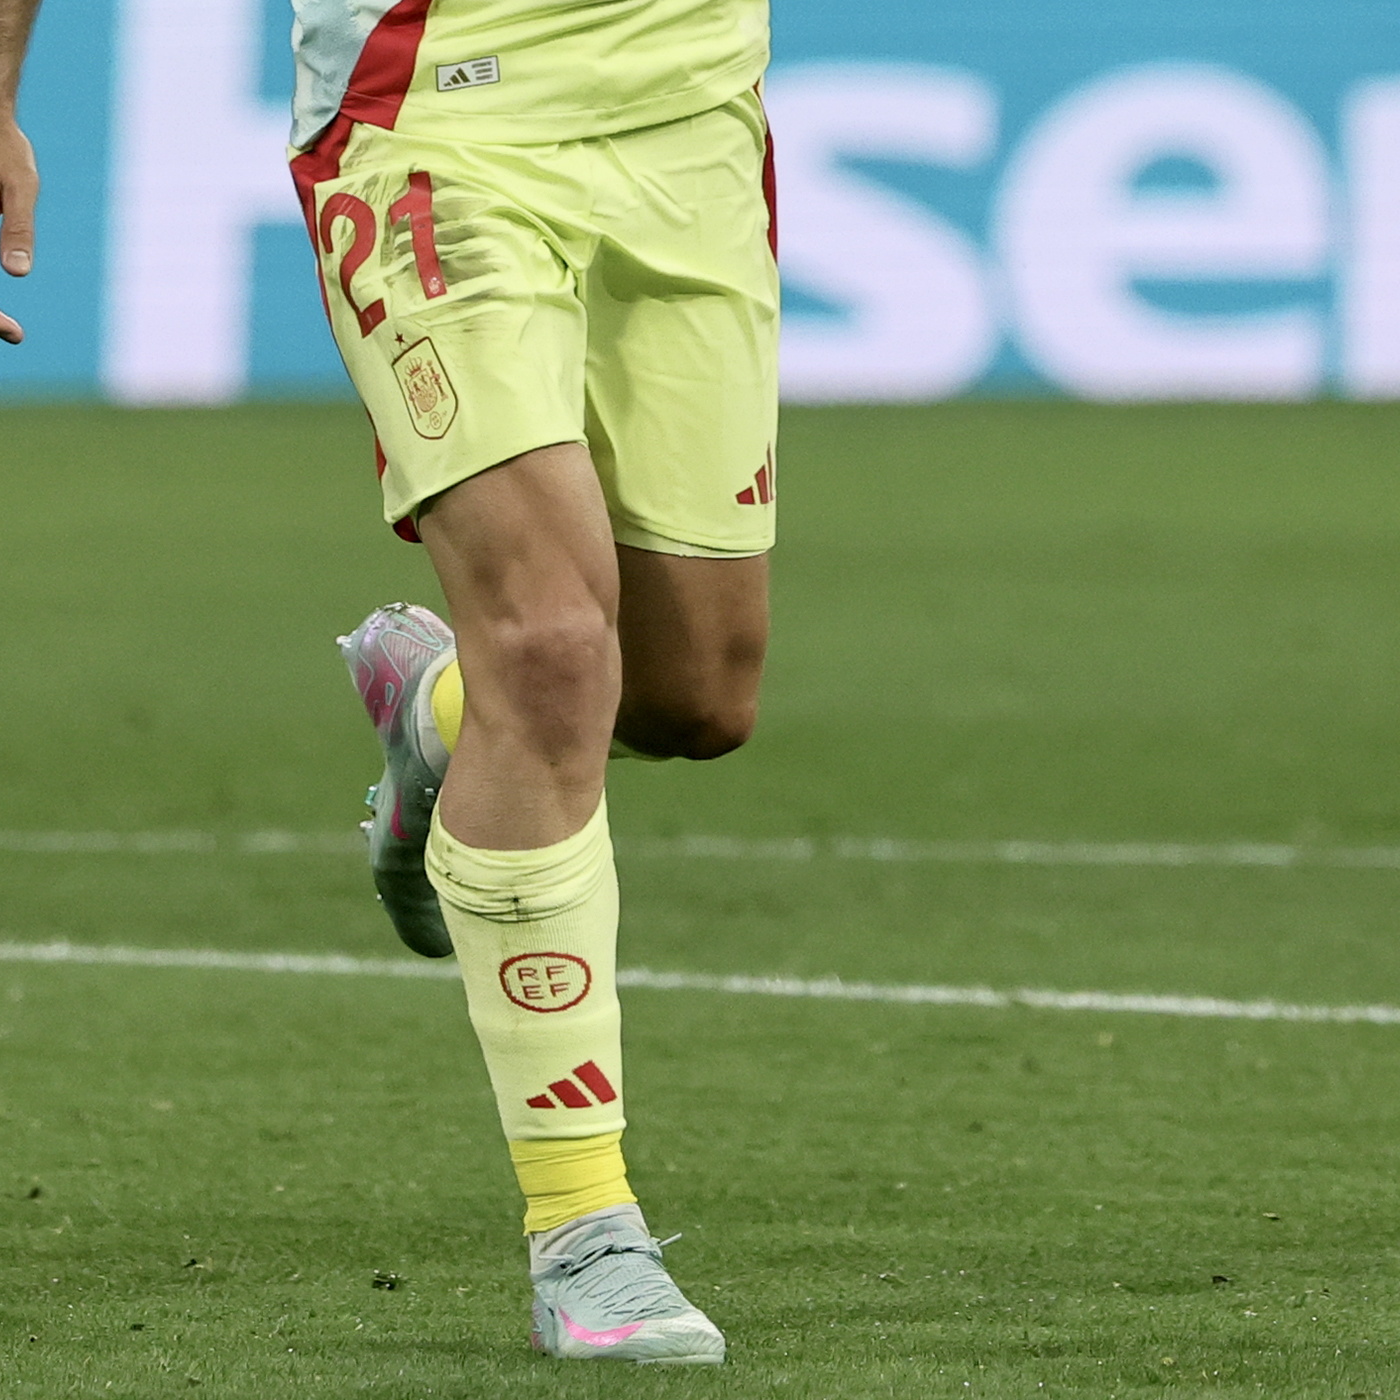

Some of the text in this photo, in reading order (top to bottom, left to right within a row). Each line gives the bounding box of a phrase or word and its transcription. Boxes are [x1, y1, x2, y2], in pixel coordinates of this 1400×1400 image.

[320, 170, 448, 339] 21
[516, 964, 568, 982] RF
[522, 982, 571, 1000] EF
